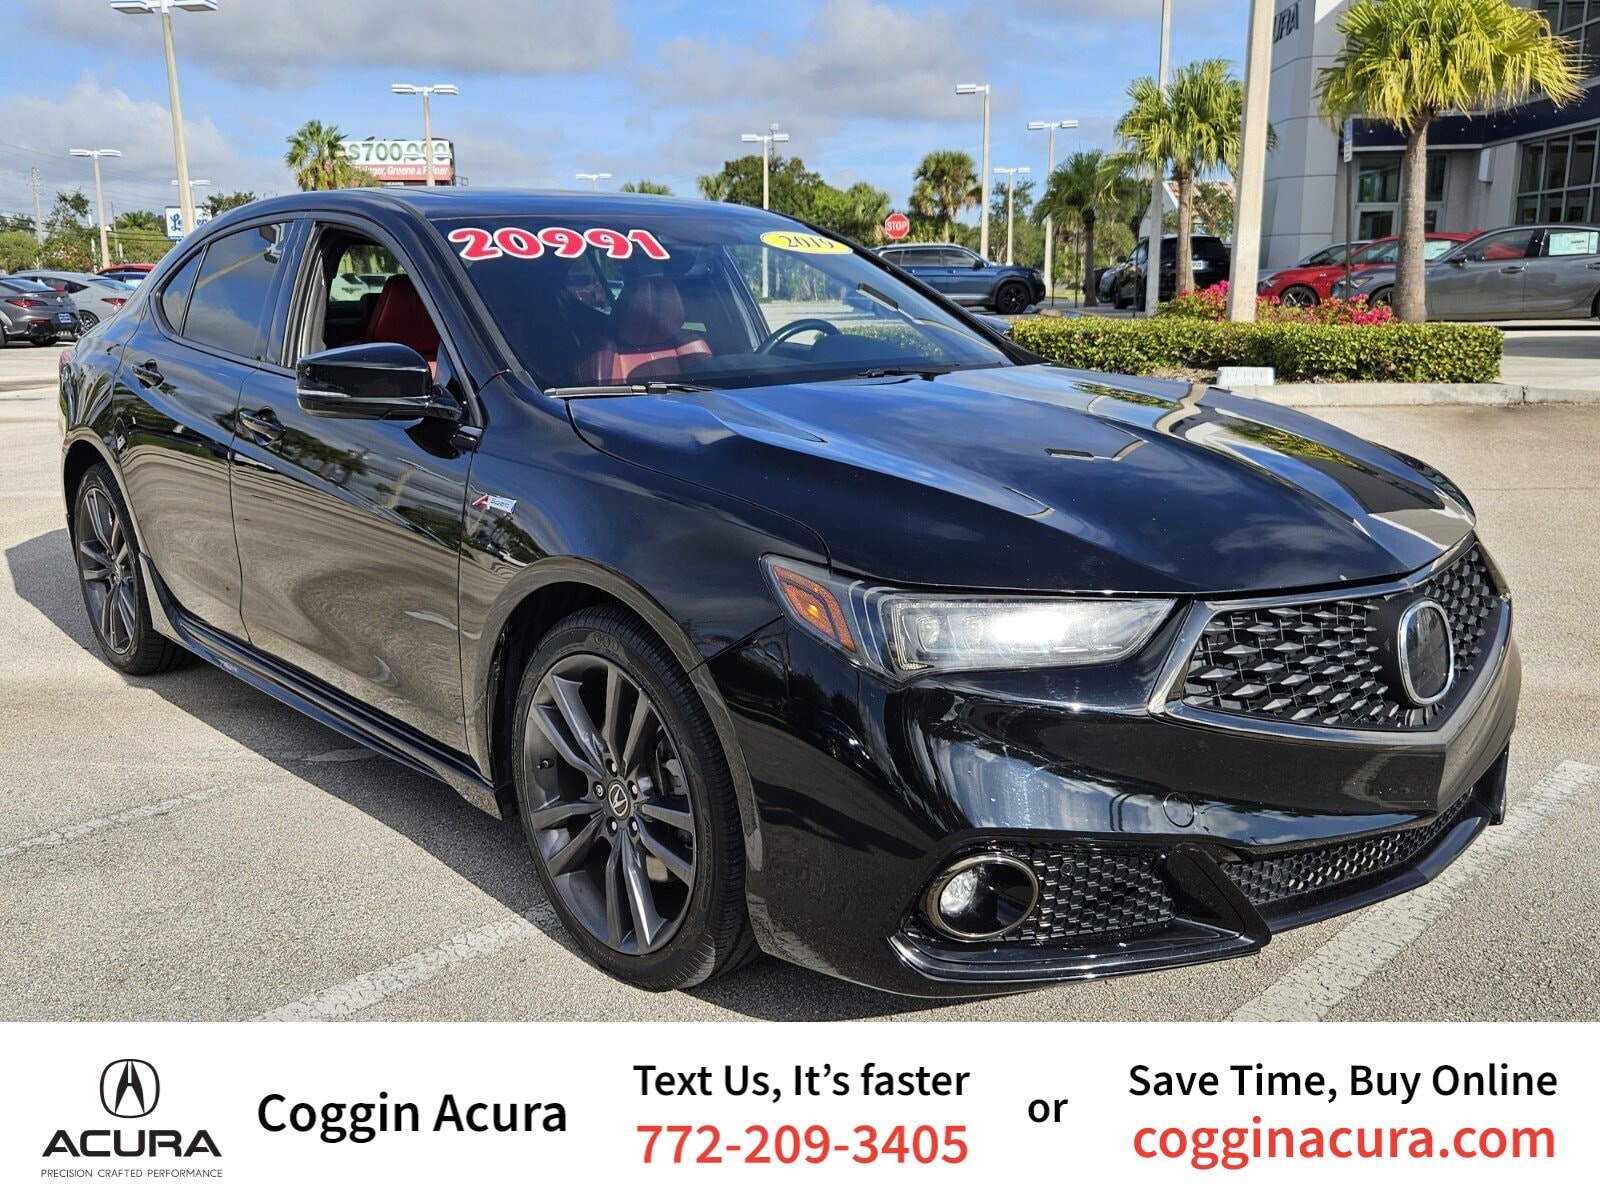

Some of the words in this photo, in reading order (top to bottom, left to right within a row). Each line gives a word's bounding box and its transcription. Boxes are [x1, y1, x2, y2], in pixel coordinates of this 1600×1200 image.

[387, 166, 416, 177] Greene
[886, 221, 907, 231] STOP
[447, 226, 671, 261] 20991
